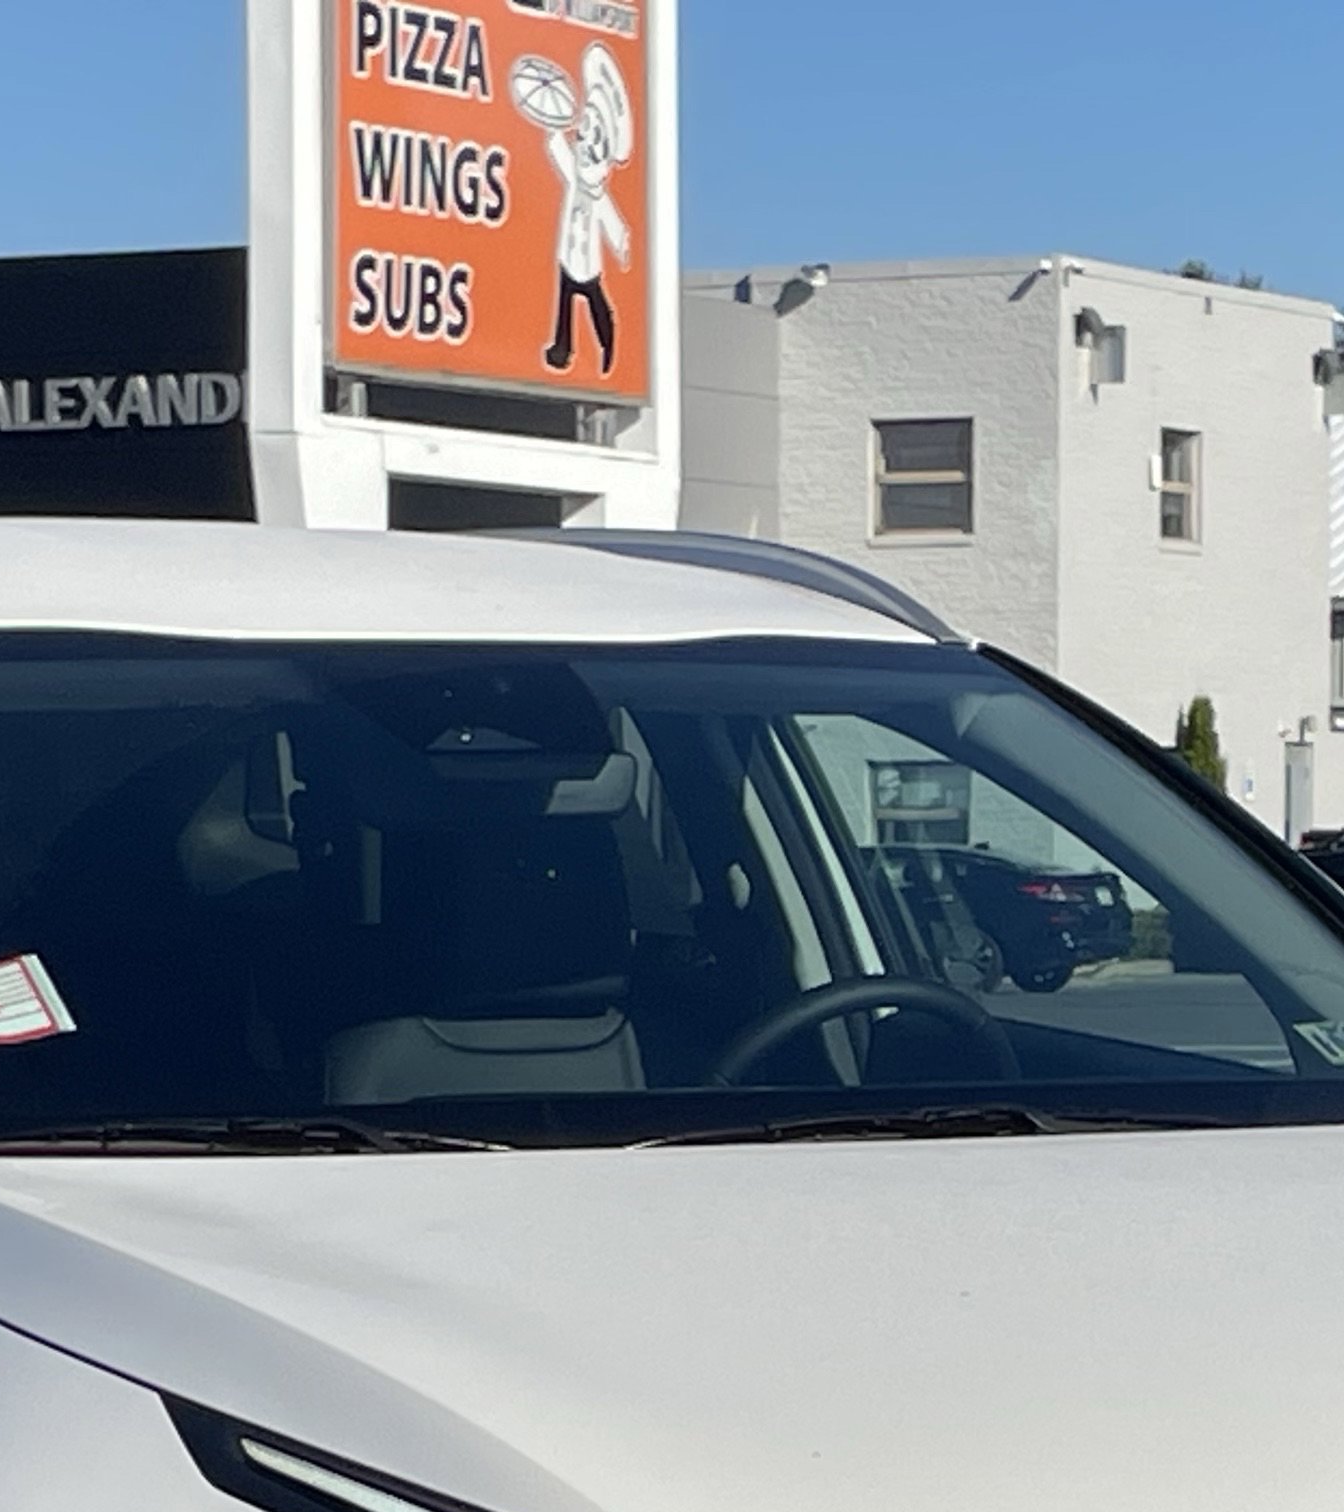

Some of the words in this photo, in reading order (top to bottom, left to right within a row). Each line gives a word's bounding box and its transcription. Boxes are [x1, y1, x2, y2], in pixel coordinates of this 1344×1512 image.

[355, 3, 490, 98] PIZZA
[353, 127, 506, 221] WINGS
[352, 253, 470, 339] SUBS
